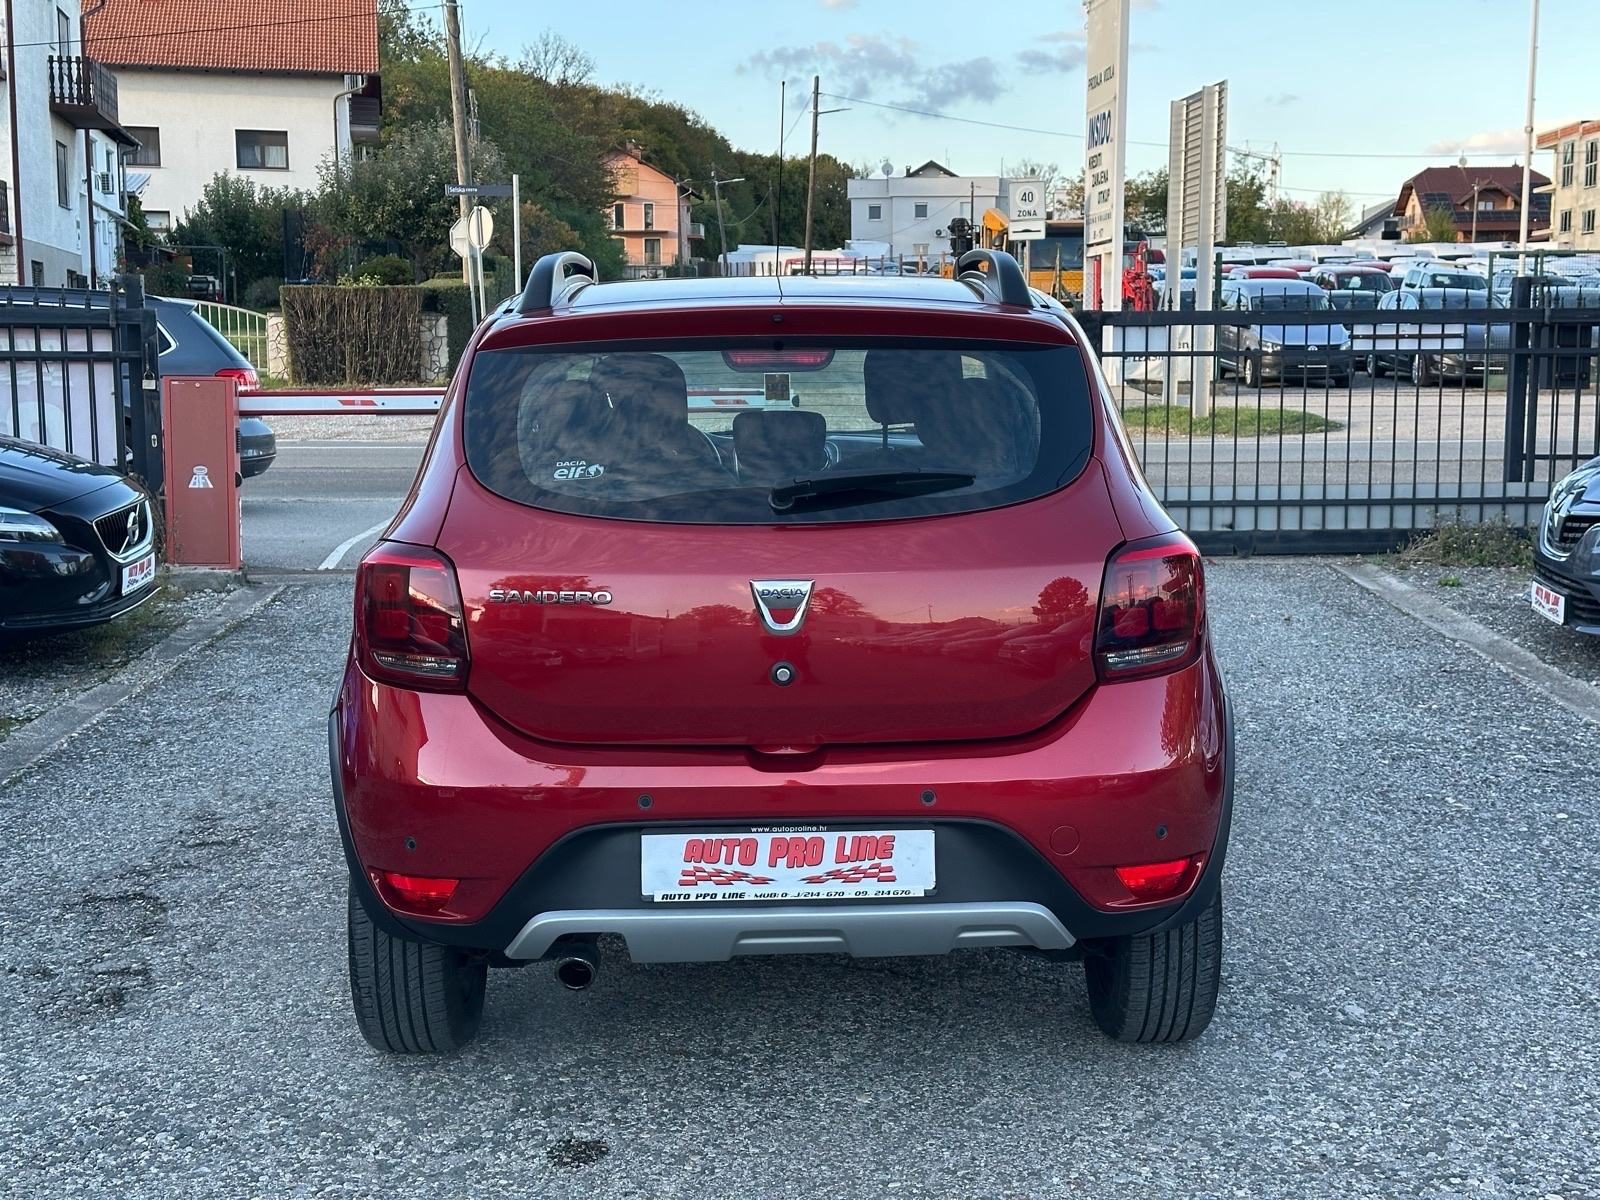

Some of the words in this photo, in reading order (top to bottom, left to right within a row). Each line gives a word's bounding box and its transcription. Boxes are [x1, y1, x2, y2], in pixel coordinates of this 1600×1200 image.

[1021, 191, 1034, 203] 40
[1017, 209, 1038, 218] ZONA
[553, 466, 587, 479] elf
[489, 589, 613, 605] SANDERO
[761, 588, 805, 599] DACIA
[750, 825, 828, 833] www.autoproline.hr
[683, 838, 759, 866] AUTO
[767, 836, 826, 869] PRO
[834, 835, 896, 864] LINE
[661, 893, 691, 901] AUTO
[721, 891, 747, 899] LINE
